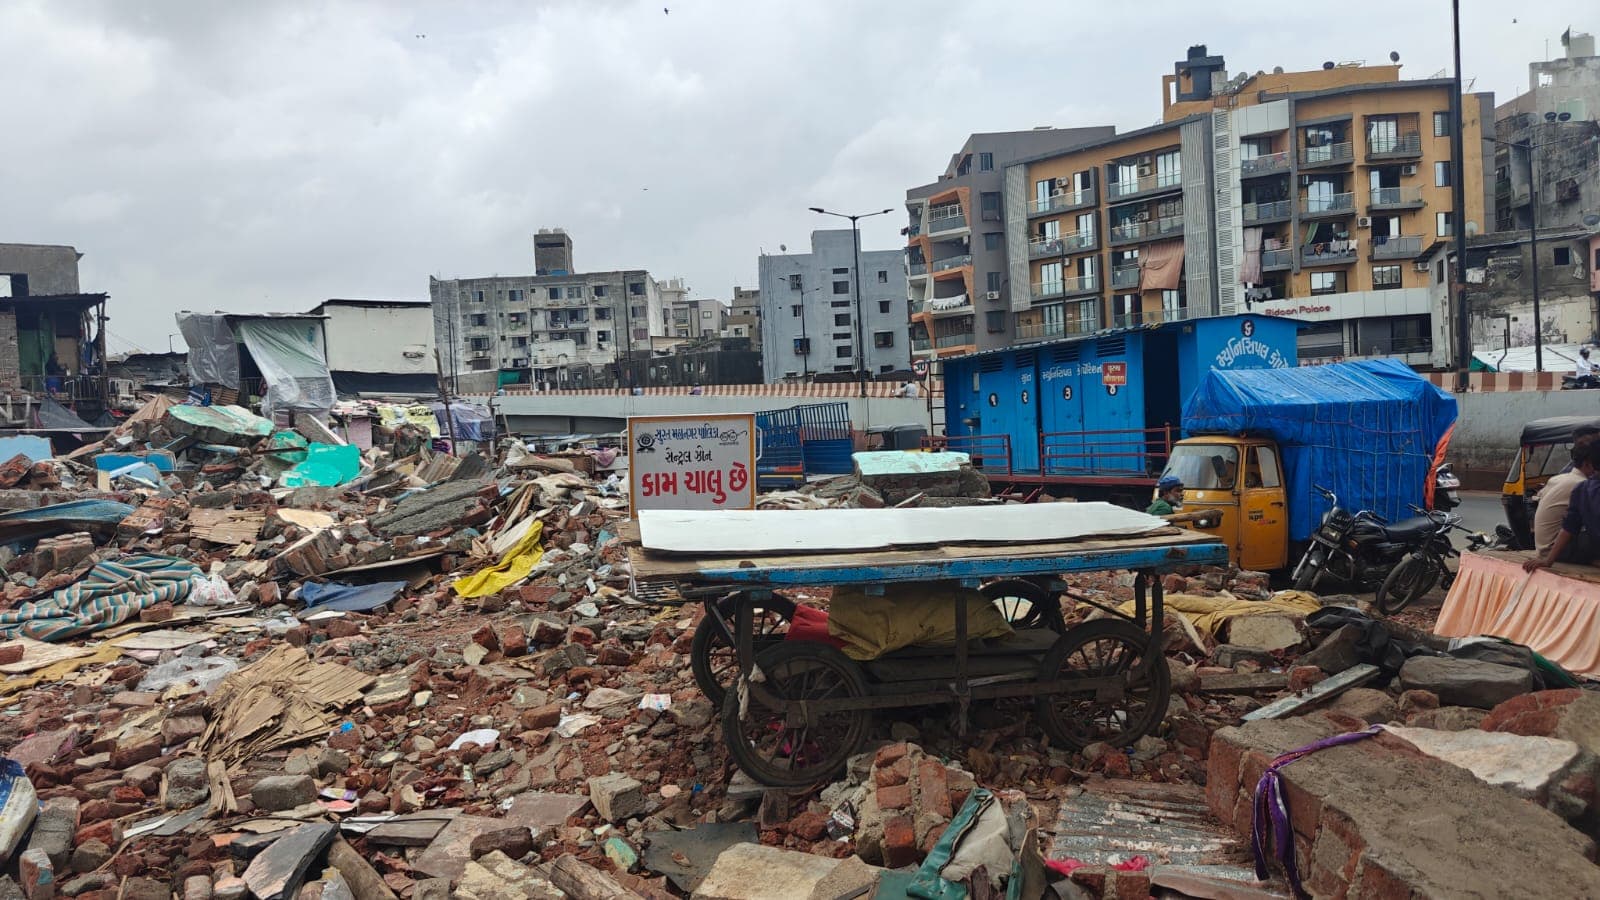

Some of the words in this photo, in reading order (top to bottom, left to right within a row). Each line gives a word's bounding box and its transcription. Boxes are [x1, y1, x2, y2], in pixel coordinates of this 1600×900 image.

[654, 428, 671, 445] સુરત
[672, 428, 697, 440] મહાનગર
[698, 423, 719, 439] પાલિકા
[694, 445, 713, 462] ઝોન
[642, 472, 678, 496] કામ
[684, 470, 727, 504] ચાલુ
[729, 461, 748, 492] છે
